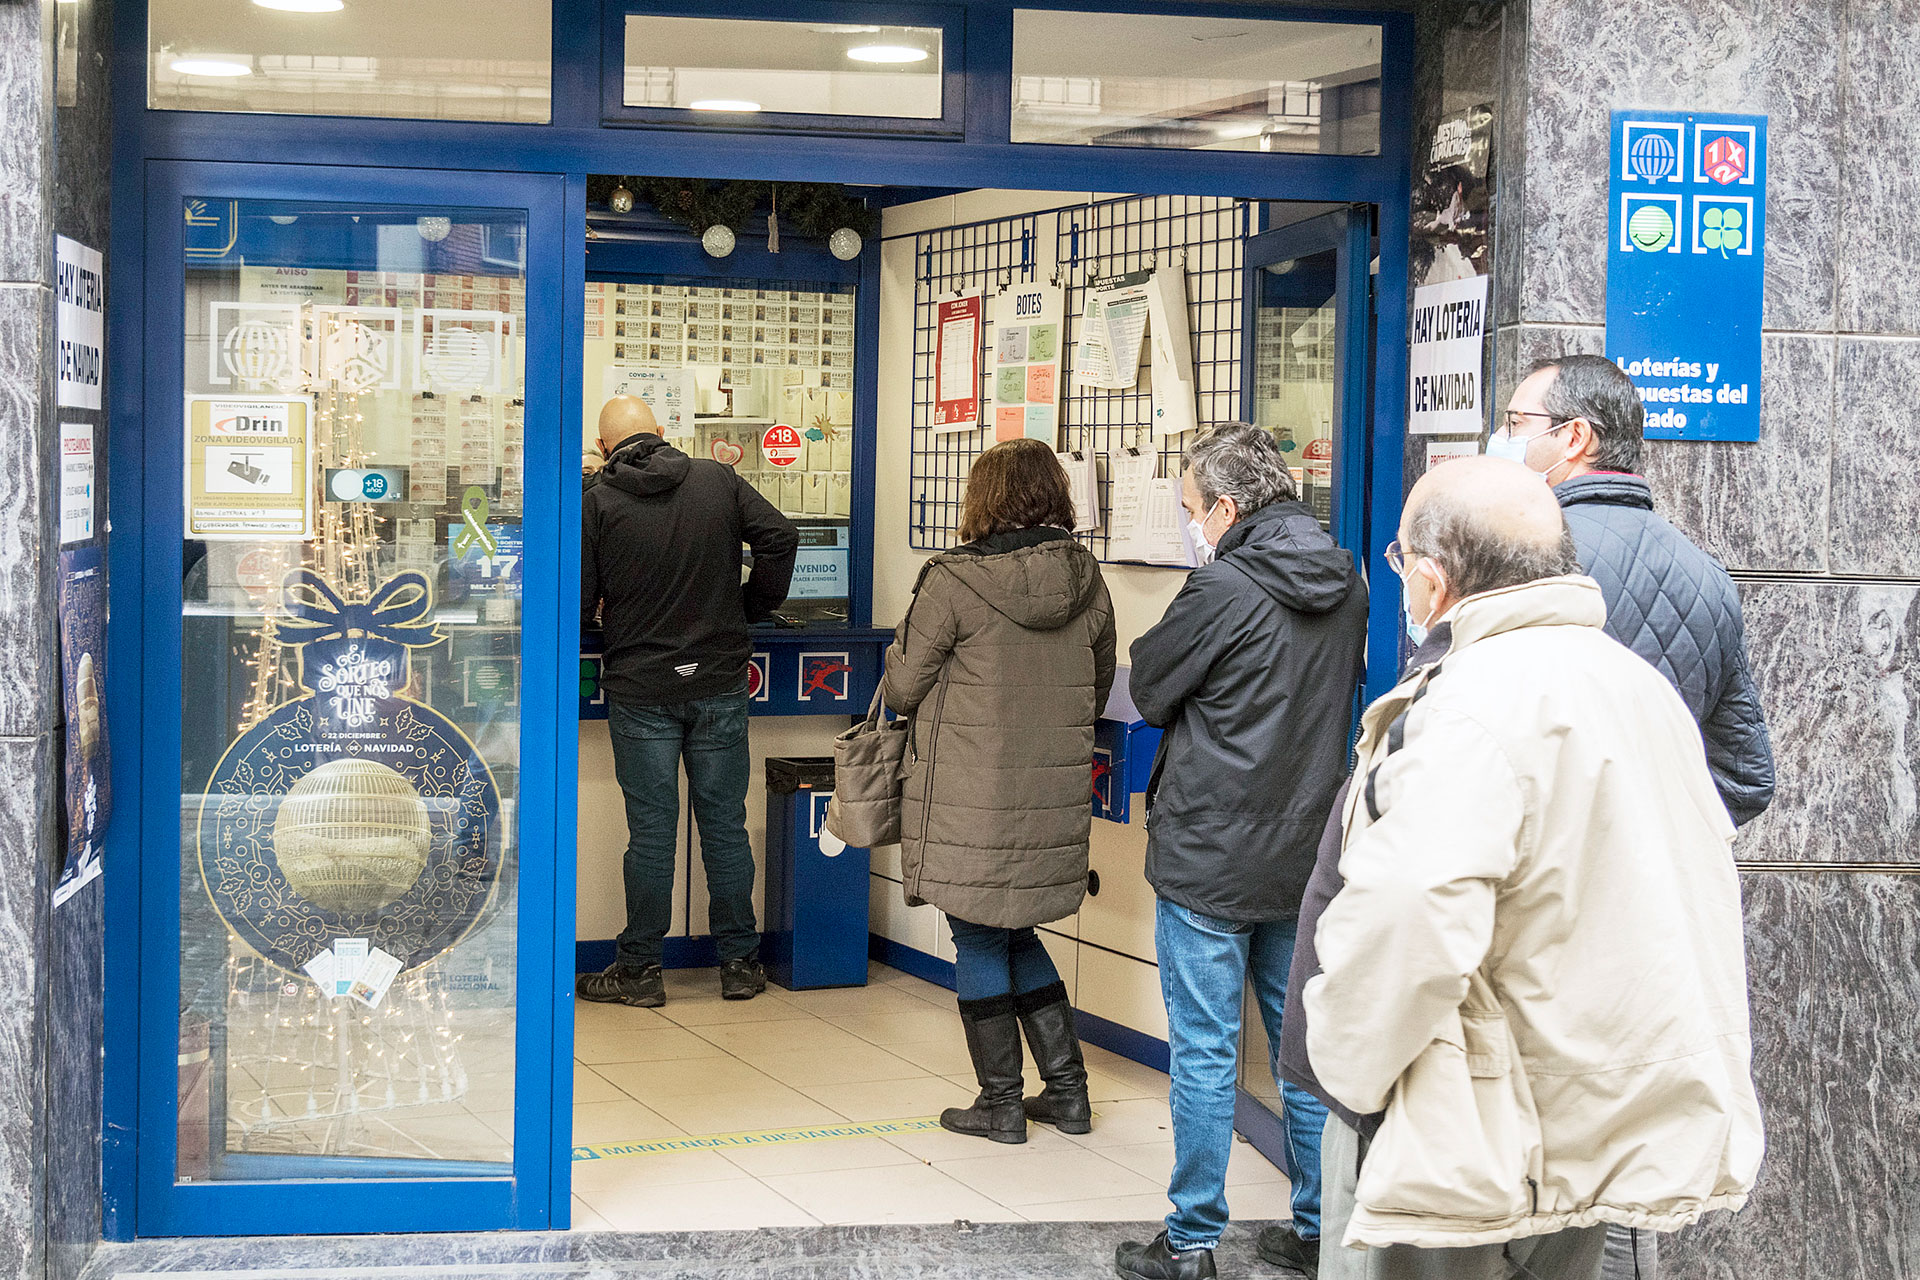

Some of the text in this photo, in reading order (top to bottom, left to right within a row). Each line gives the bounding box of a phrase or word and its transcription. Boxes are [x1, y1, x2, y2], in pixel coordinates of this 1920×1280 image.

[276, 267, 308, 276] AVISO
[1094, 275, 1126, 287] PUESTAS
[58, 260, 102, 313] HAY LOTERIA
[1096, 283, 1116, 292] PORTE
[1016, 292, 1042, 315] BOTES
[1414, 299, 1480, 344] HAY LOTERIA
[60, 340, 100, 386] DE NAVIDAD
[1617, 357, 1719, 383] Loterías y
[1415, 372, 1474, 412] DE NAVIDAD
[1637, 384, 1748, 404] puestas del
[236, 415, 282, 432] Drin
[1643, 408, 1687, 428] tado
[194, 435, 303, 444] ZONA VIDEOVIGILADA
[770, 429, 792, 443] +18
[365, 479, 383, 488] +18
[476, 555, 518, 578] 17
[794, 564, 837, 573] NVENIDO
[318, 660, 391, 692] SORTEO
[336, 678, 390, 699] QUE NOS
[329, 696, 376, 727] UNE
[295, 742, 342, 752] LOTERÍA
[364, 744, 414, 752] NAVIDAD
[449, 973, 489, 983] LOTERÍA
[602, 1137, 728, 1156] MANTENGA
[728, 1136, 760, 1145] LA
[760, 1127, 874, 1142] DISTANCIA
[872, 1123, 906, 1133] DE
